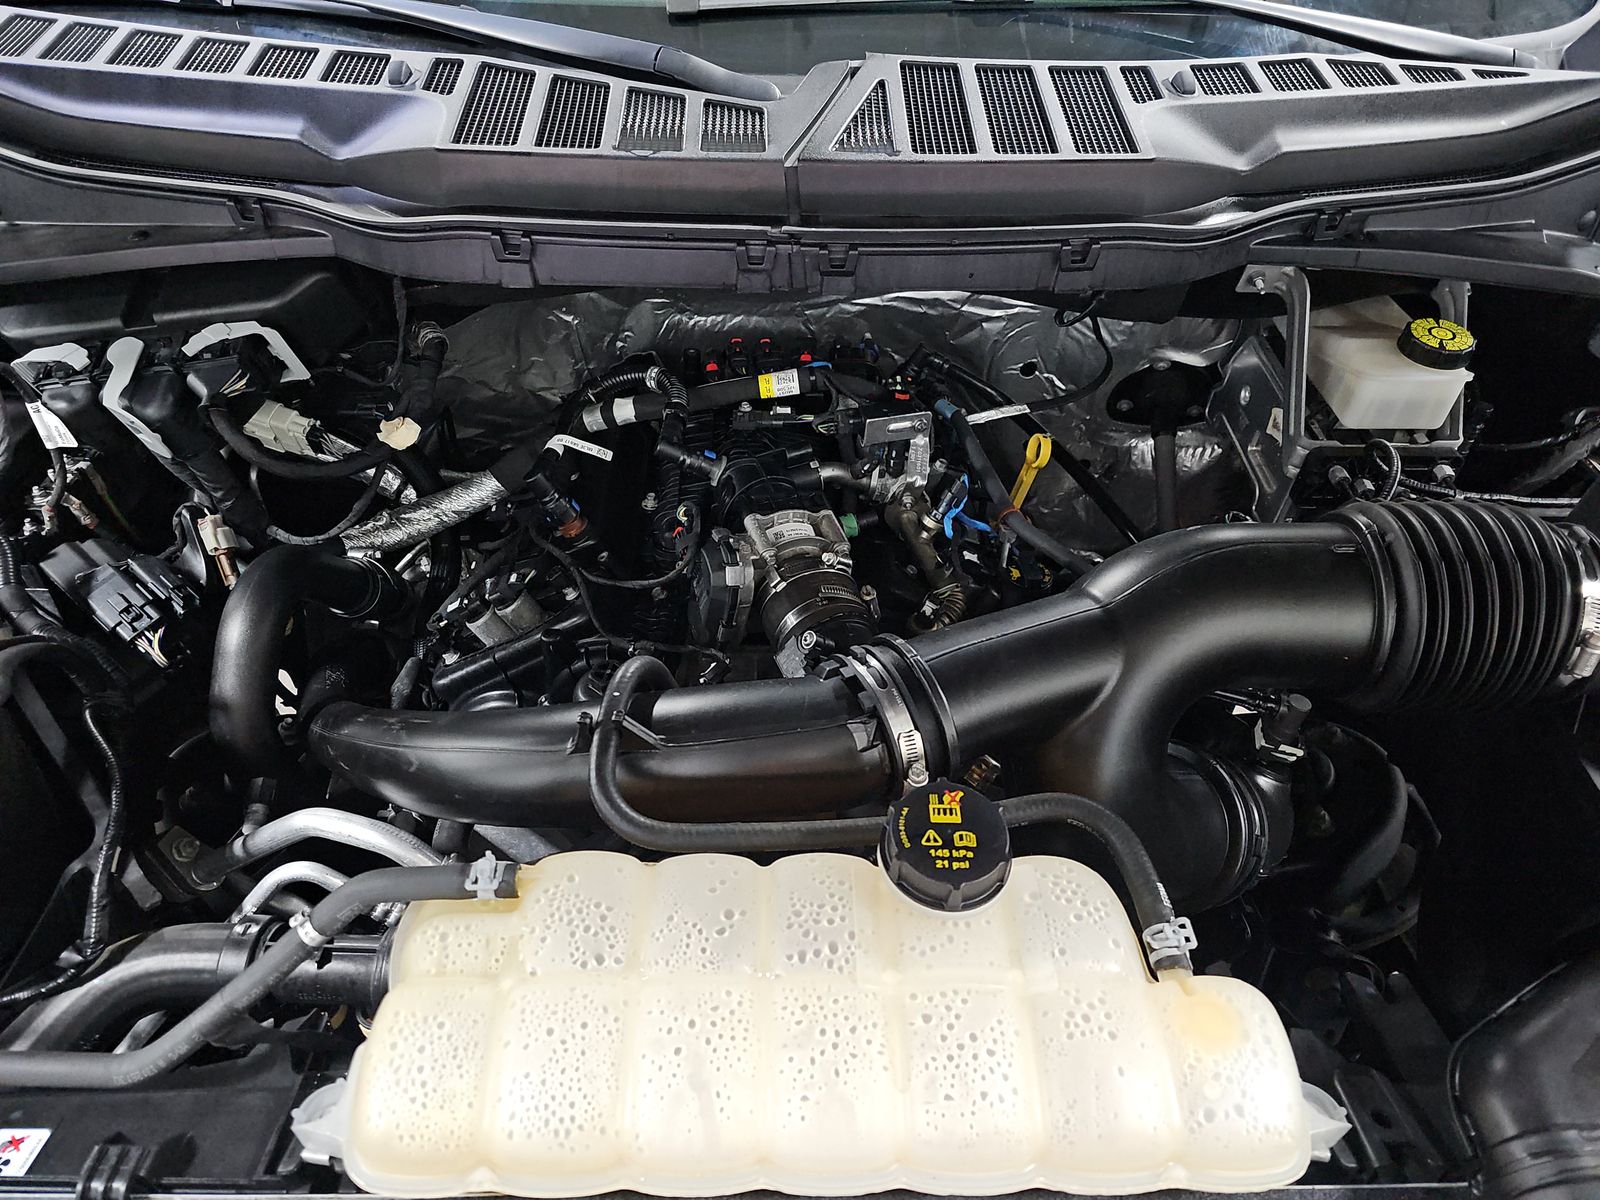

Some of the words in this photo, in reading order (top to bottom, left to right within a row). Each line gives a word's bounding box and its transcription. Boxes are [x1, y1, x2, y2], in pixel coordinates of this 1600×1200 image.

[929, 848, 950, 858] 145
[952, 849, 974, 858] kPa
[935, 860, 949, 869] 21
[952, 860, 970, 870] psi
